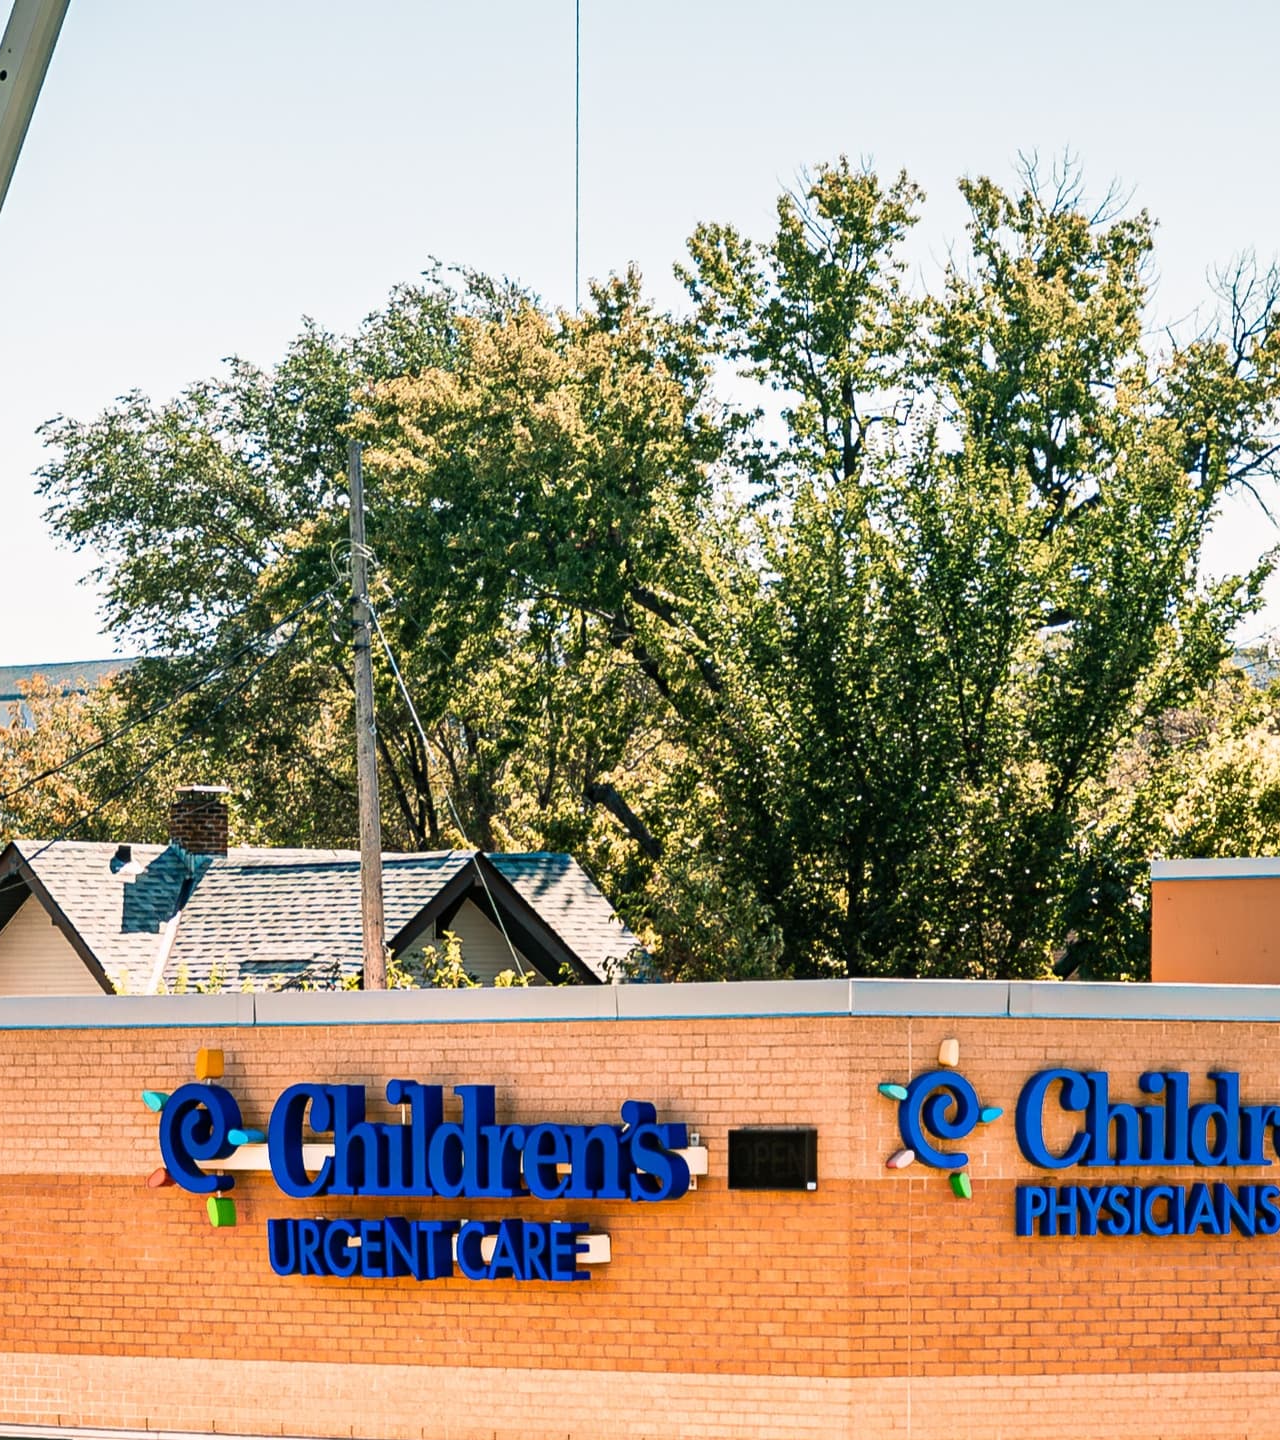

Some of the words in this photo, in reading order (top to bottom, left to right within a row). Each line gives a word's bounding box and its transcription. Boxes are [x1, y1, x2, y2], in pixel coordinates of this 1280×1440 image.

[268, 1079, 691, 1202] Children's
[734, 1142, 805, 1176] OPEN
[268, 1217, 453, 1280] URGENT
[456, 1220, 590, 1281] CARE
